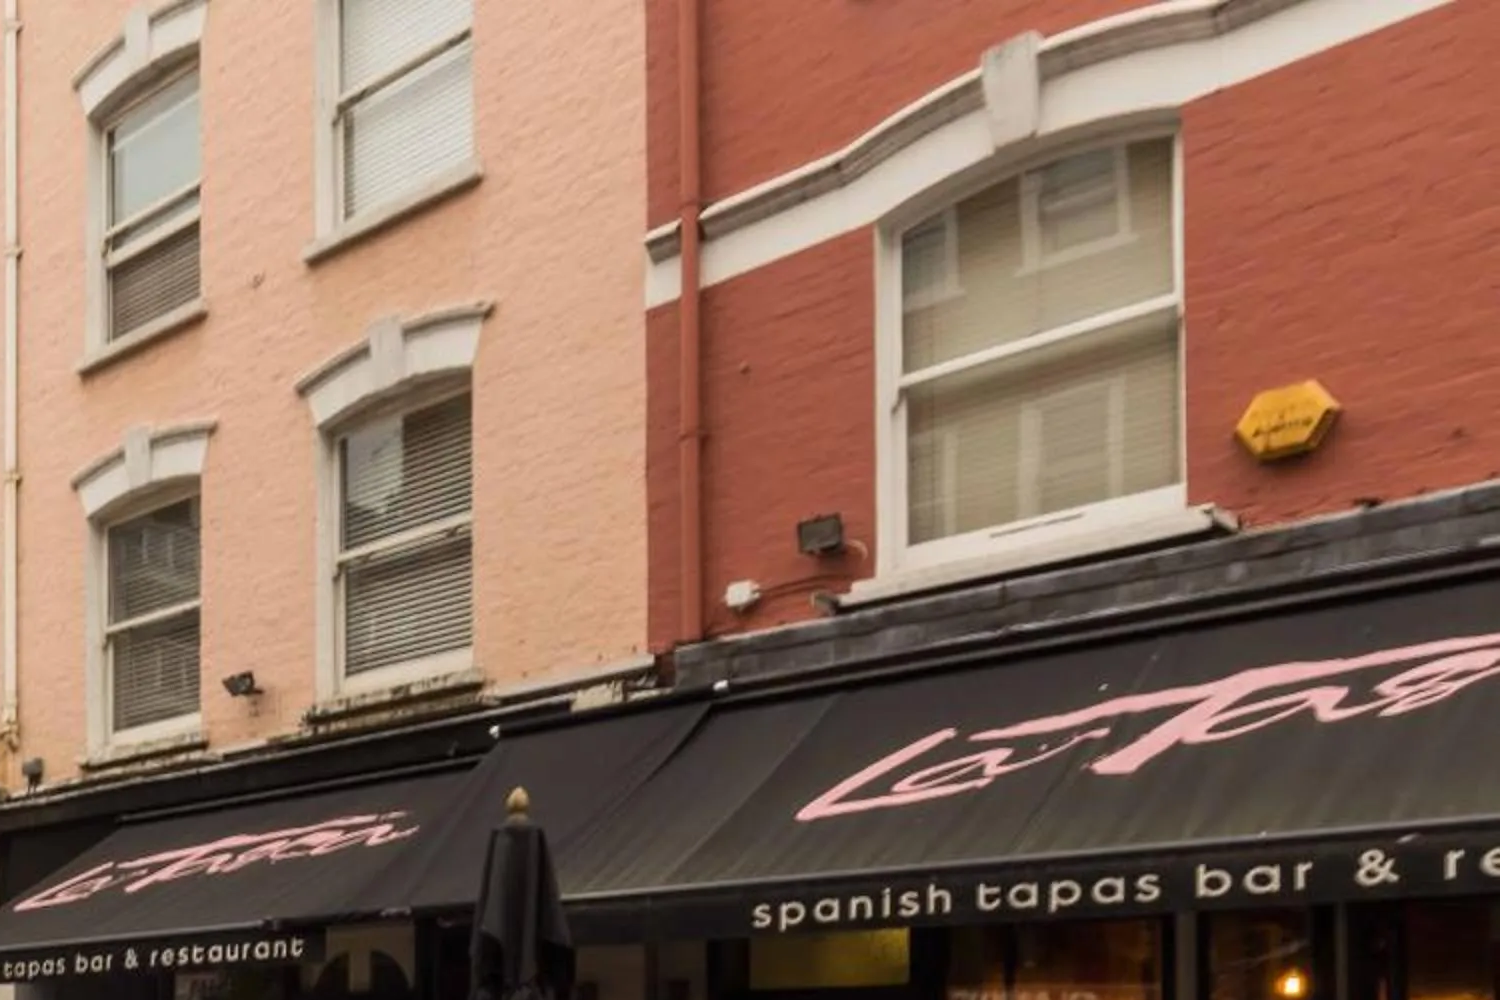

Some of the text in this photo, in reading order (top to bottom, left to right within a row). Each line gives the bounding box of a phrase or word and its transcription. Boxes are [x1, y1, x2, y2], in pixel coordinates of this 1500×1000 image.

[752, 883, 952, 931] spanish
[977, 874, 1161, 913] tapas
[1195, 863, 1313, 897] bar
[1355, 848, 1400, 887] &
[3, 957, 66, 978] tapas
[75, 952, 114, 973] bar
[123, 948, 139, 970] &
[149, 937, 304, 967] restaurant
